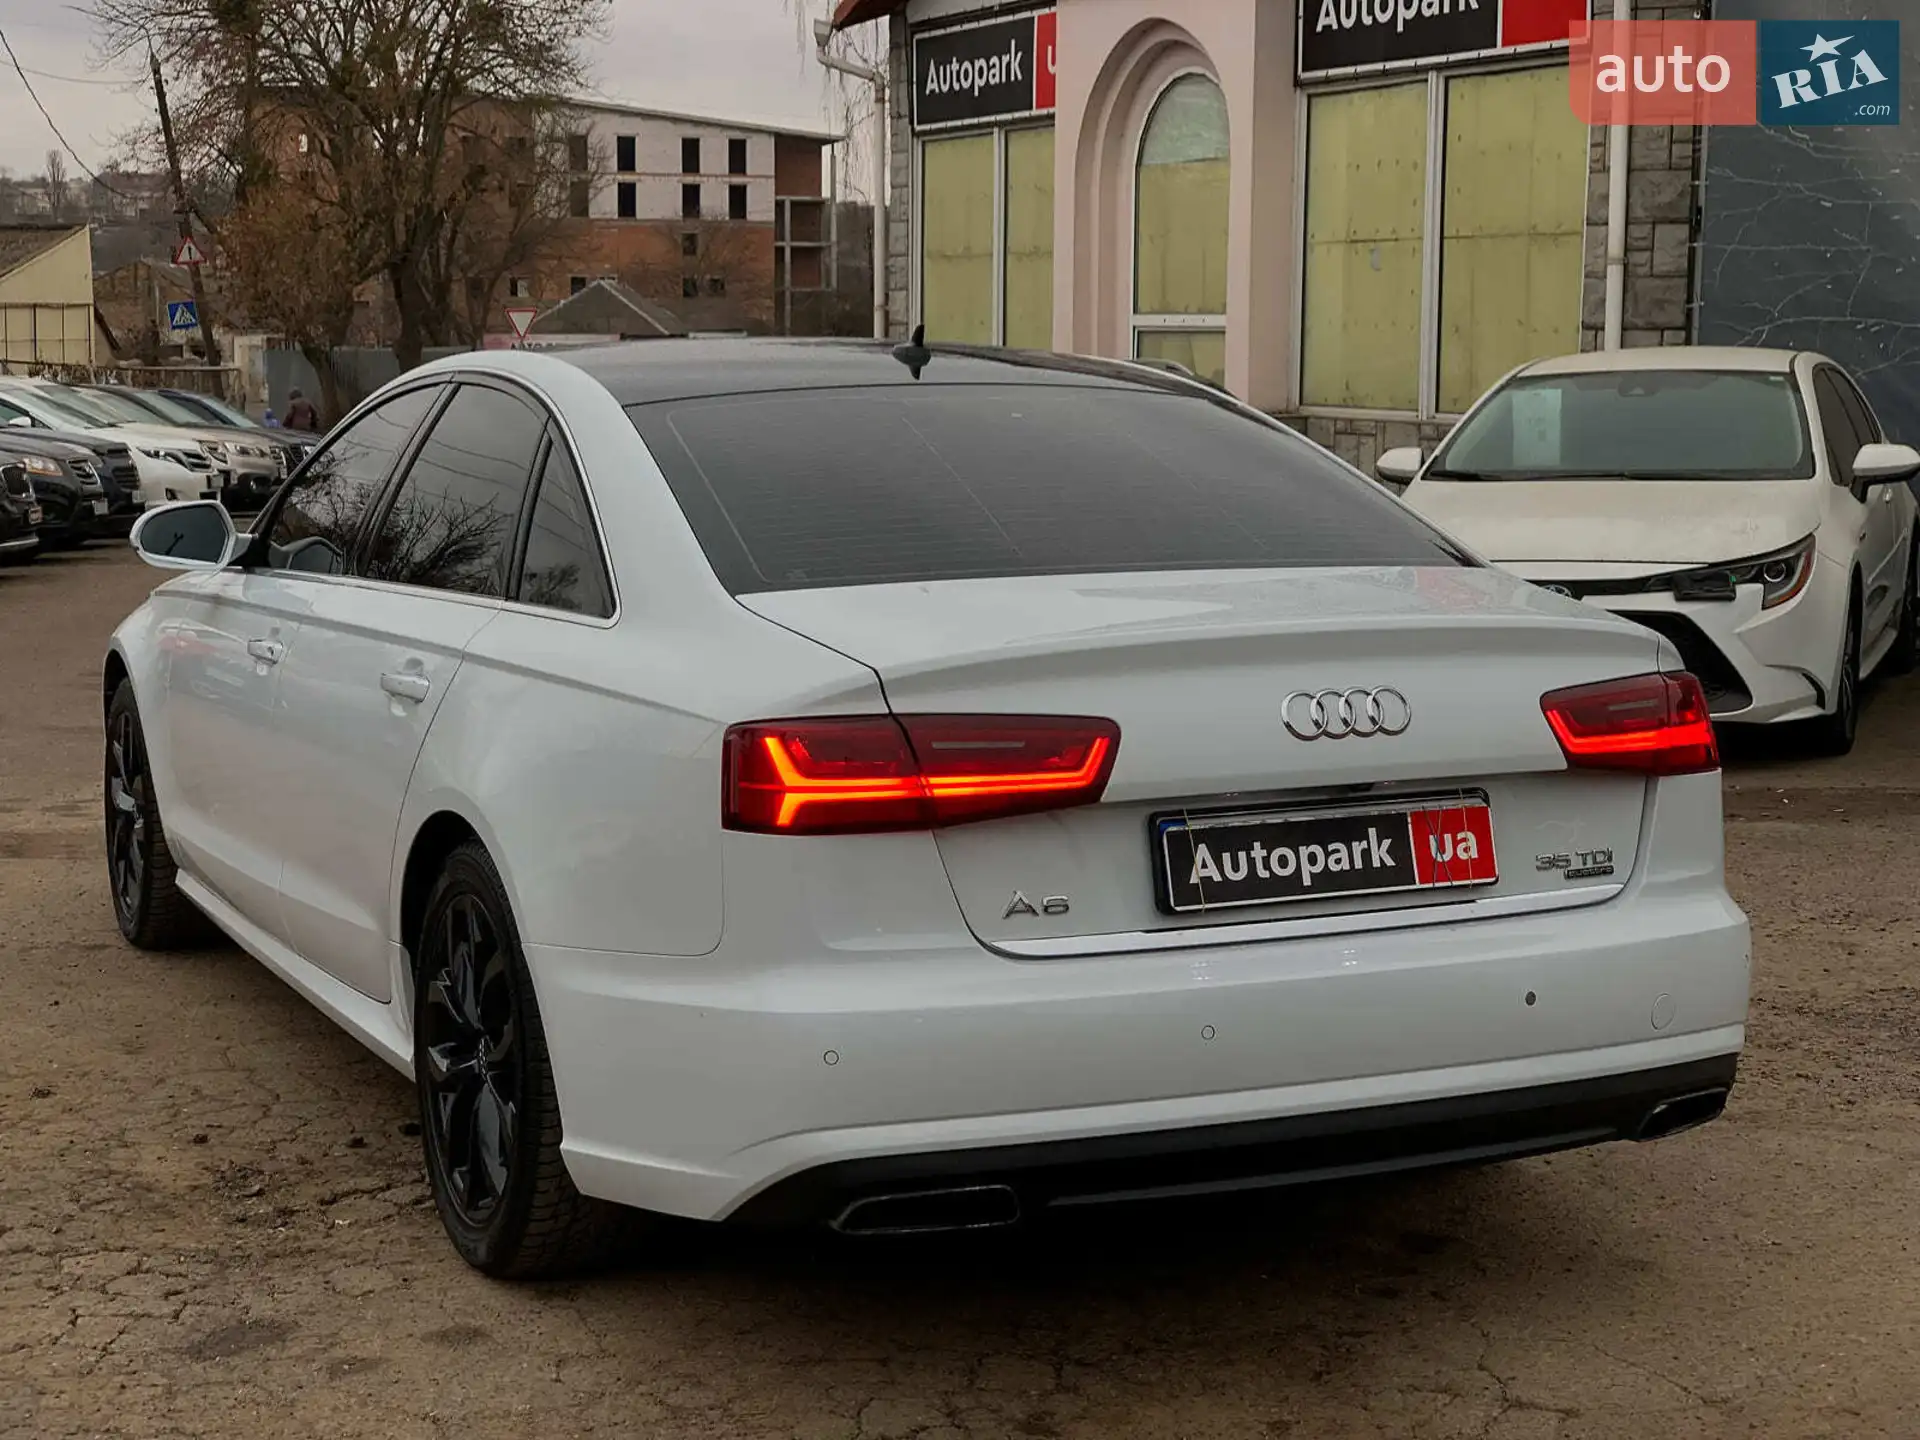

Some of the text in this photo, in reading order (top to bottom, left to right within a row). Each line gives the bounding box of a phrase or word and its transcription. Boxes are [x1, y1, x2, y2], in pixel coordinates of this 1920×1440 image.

[1315, 0, 1480, 33] Autopa
[925, 38, 1022, 97] Autopark
[1189, 827, 1479, 886] Autopark ua
[1535, 848, 1613, 871] 35 TDI
[1002, 890, 1069, 920] A6
